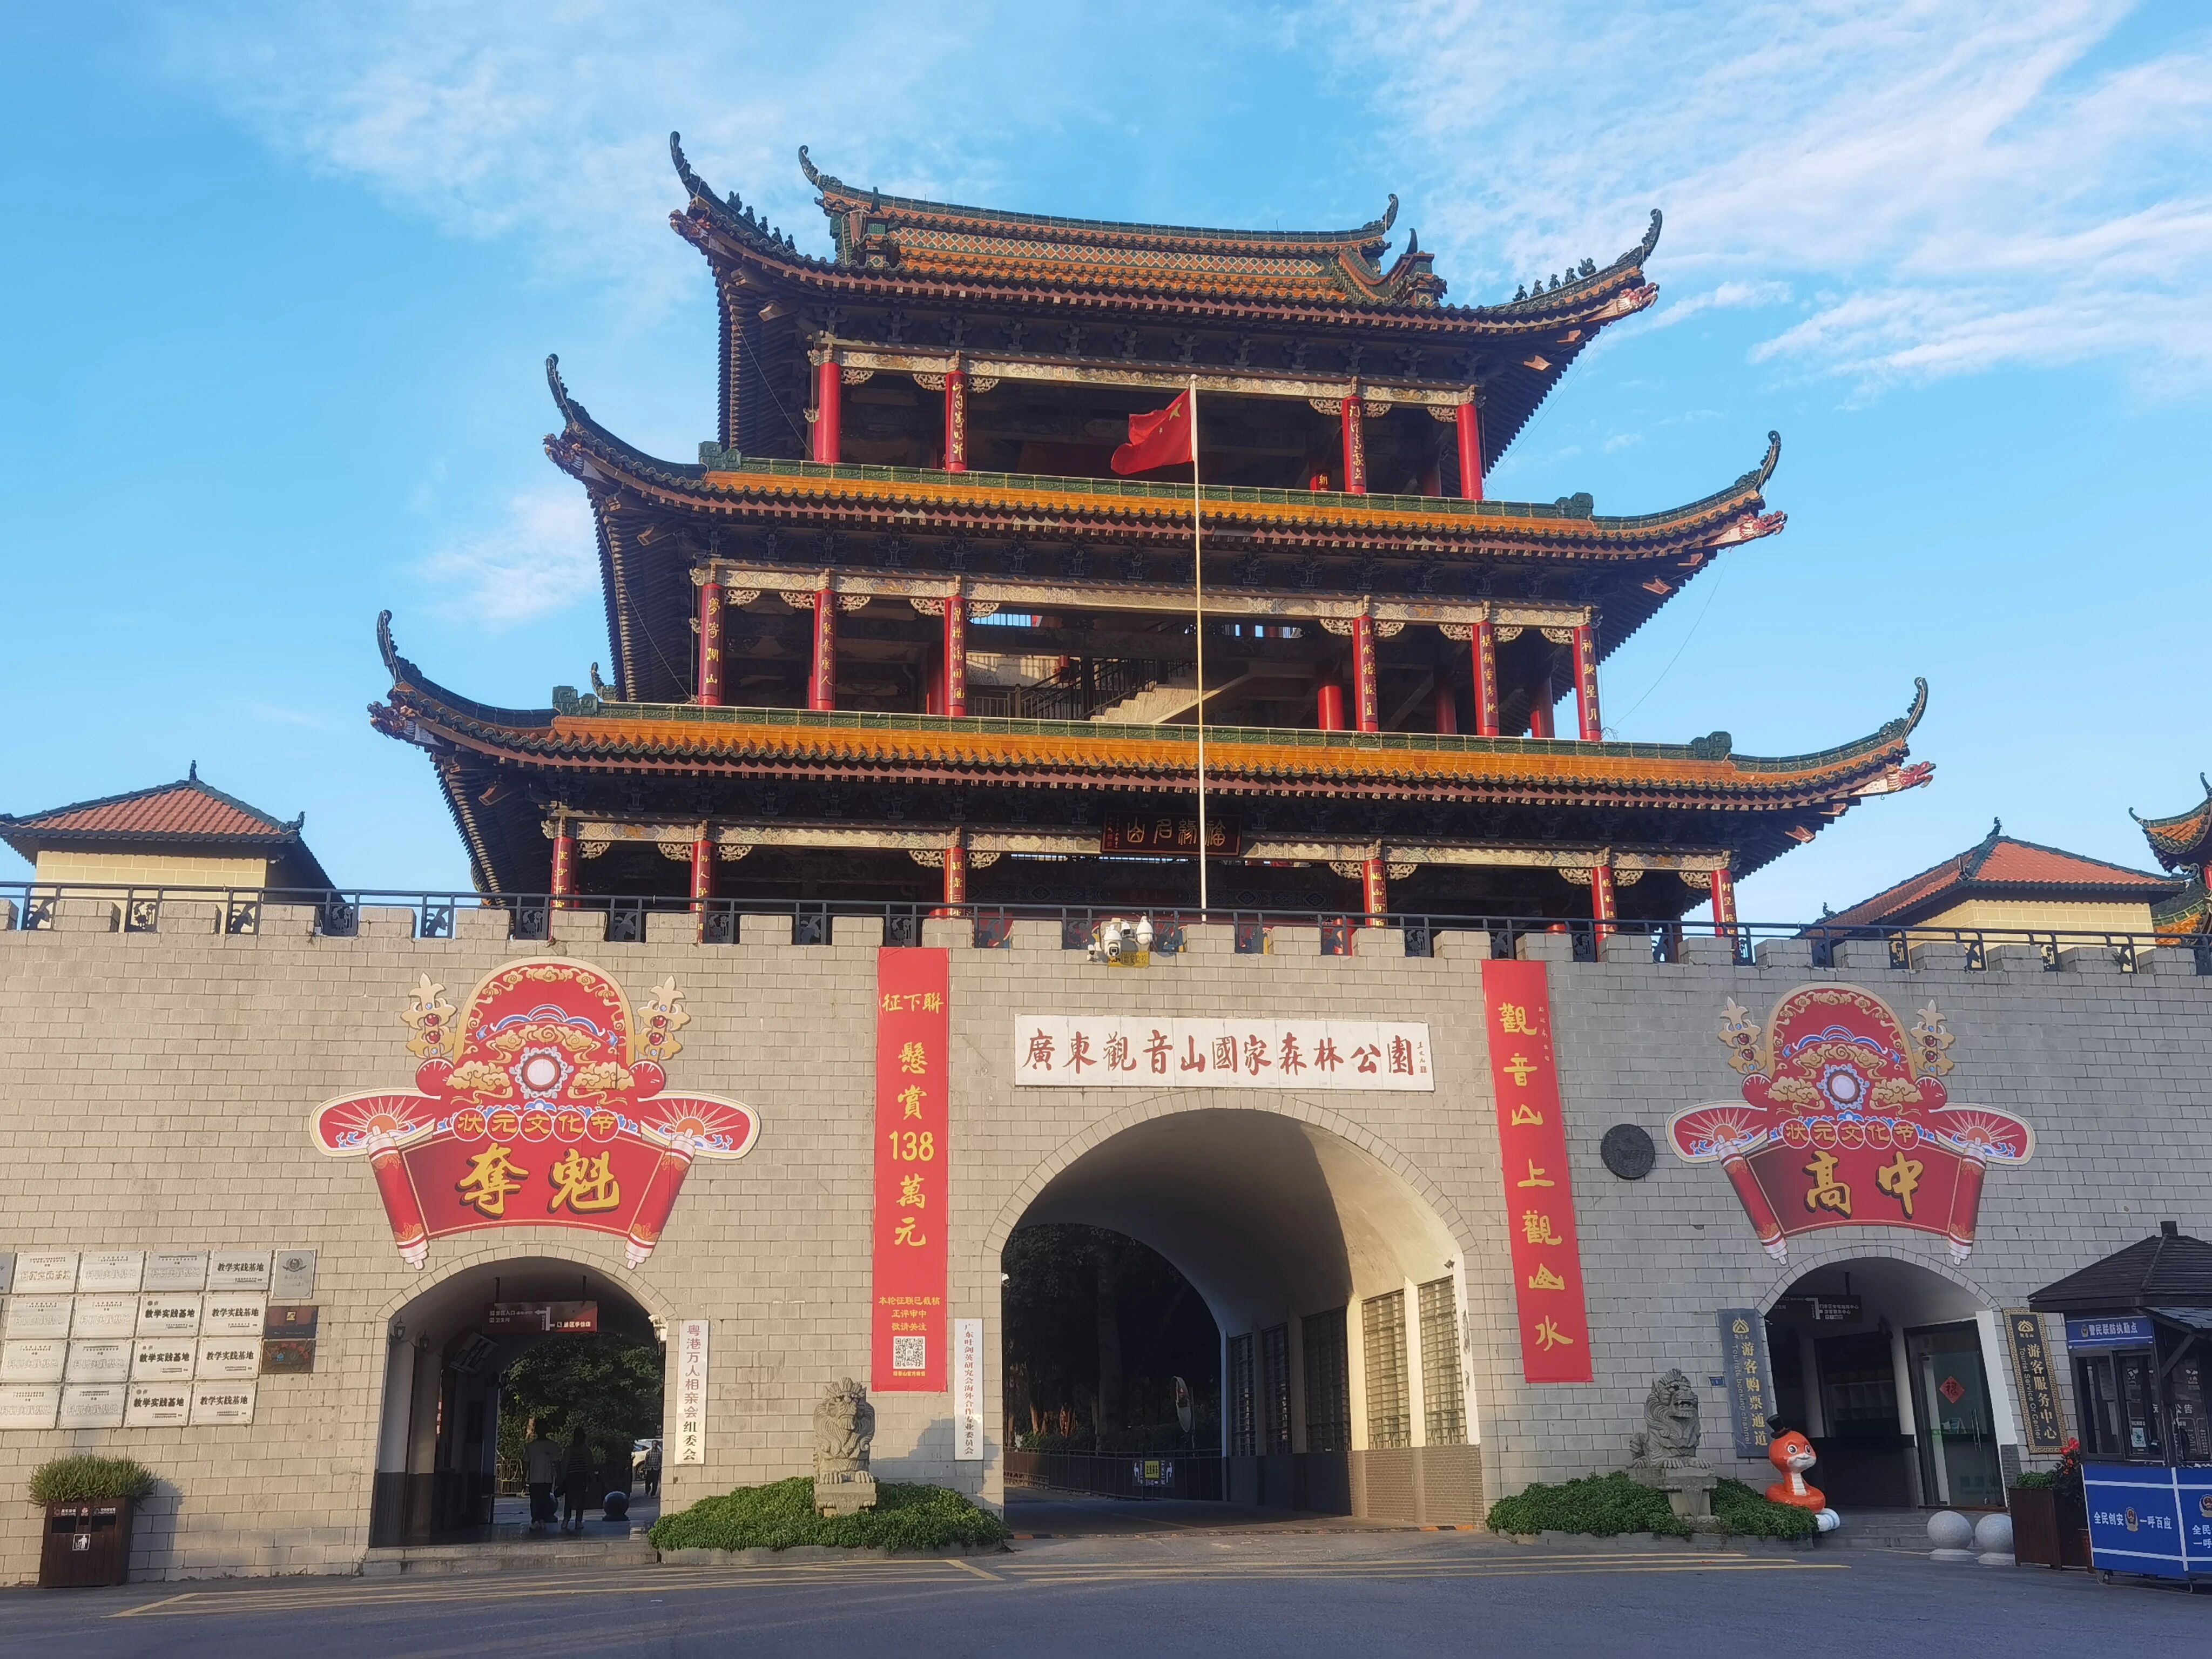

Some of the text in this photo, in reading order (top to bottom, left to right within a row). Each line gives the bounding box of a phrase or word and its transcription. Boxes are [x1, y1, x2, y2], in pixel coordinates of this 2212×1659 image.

[1024, 1028, 1414, 1076] 廣東觀音山國家森林公園
[457, 1113, 616, 1136] 状元文化节
[1785, 1123, 1916, 1144] 状元文化节
[1803, 1150, 1924, 1218] 高中
[218, 1263, 264, 1272] 教学实践基地
[145, 1309, 195, 1318] 教学实践基地
[212, 1307, 259, 1317] 教学实践基地
[891, 1309, 927, 1318] 正评审中
[891, 1322, 927, 1331] 敬请关注
[139, 1352, 190, 1363] 教学实践基地
[206, 1351, 254, 1360] 教学实践基地
[683, 1325, 702, 1461] 粤港万人相亲会组委会
[1742, 1342, 1768, 1446] 游客购票通道
[2019, 1346, 2029, 1372] Tourist
[2024, 1374, 2034, 1401] Service
[2033, 1414, 2042, 1440] Center
[2027, 1343, 2057, 1440] 游客服务中心
[133, 1398, 184, 1407] 教学实践基地
[200, 1395, 248, 1405] 教学实践基地
[2094, 1511, 2172, 1529] 全民创安 一呼百应
[2192, 1525, 2212, 1535] 全民
